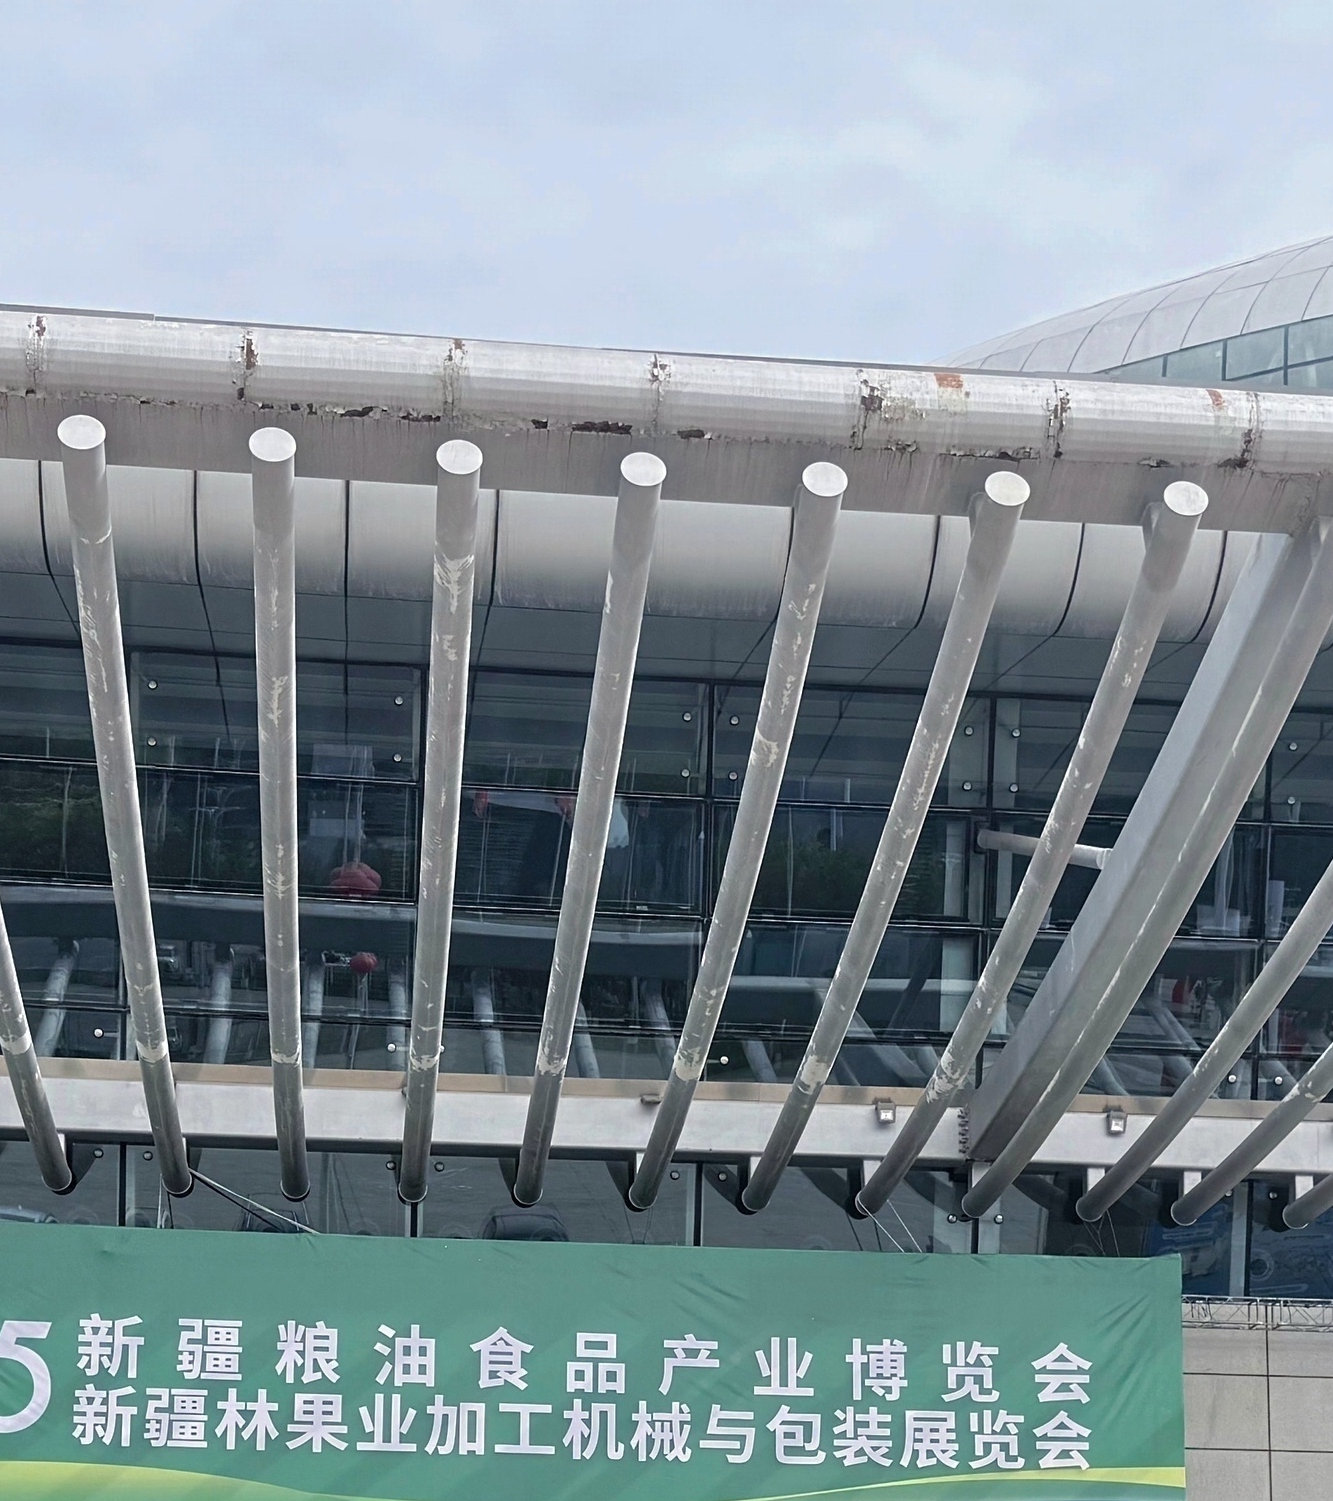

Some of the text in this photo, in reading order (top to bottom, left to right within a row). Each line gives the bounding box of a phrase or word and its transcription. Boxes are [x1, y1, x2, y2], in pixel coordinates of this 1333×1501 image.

[76, 1312, 1092, 1404] 新疆粮油食品产业博览会
[72, 1385, 1091, 1470] 新疆林果业加工机械与包装展览会
